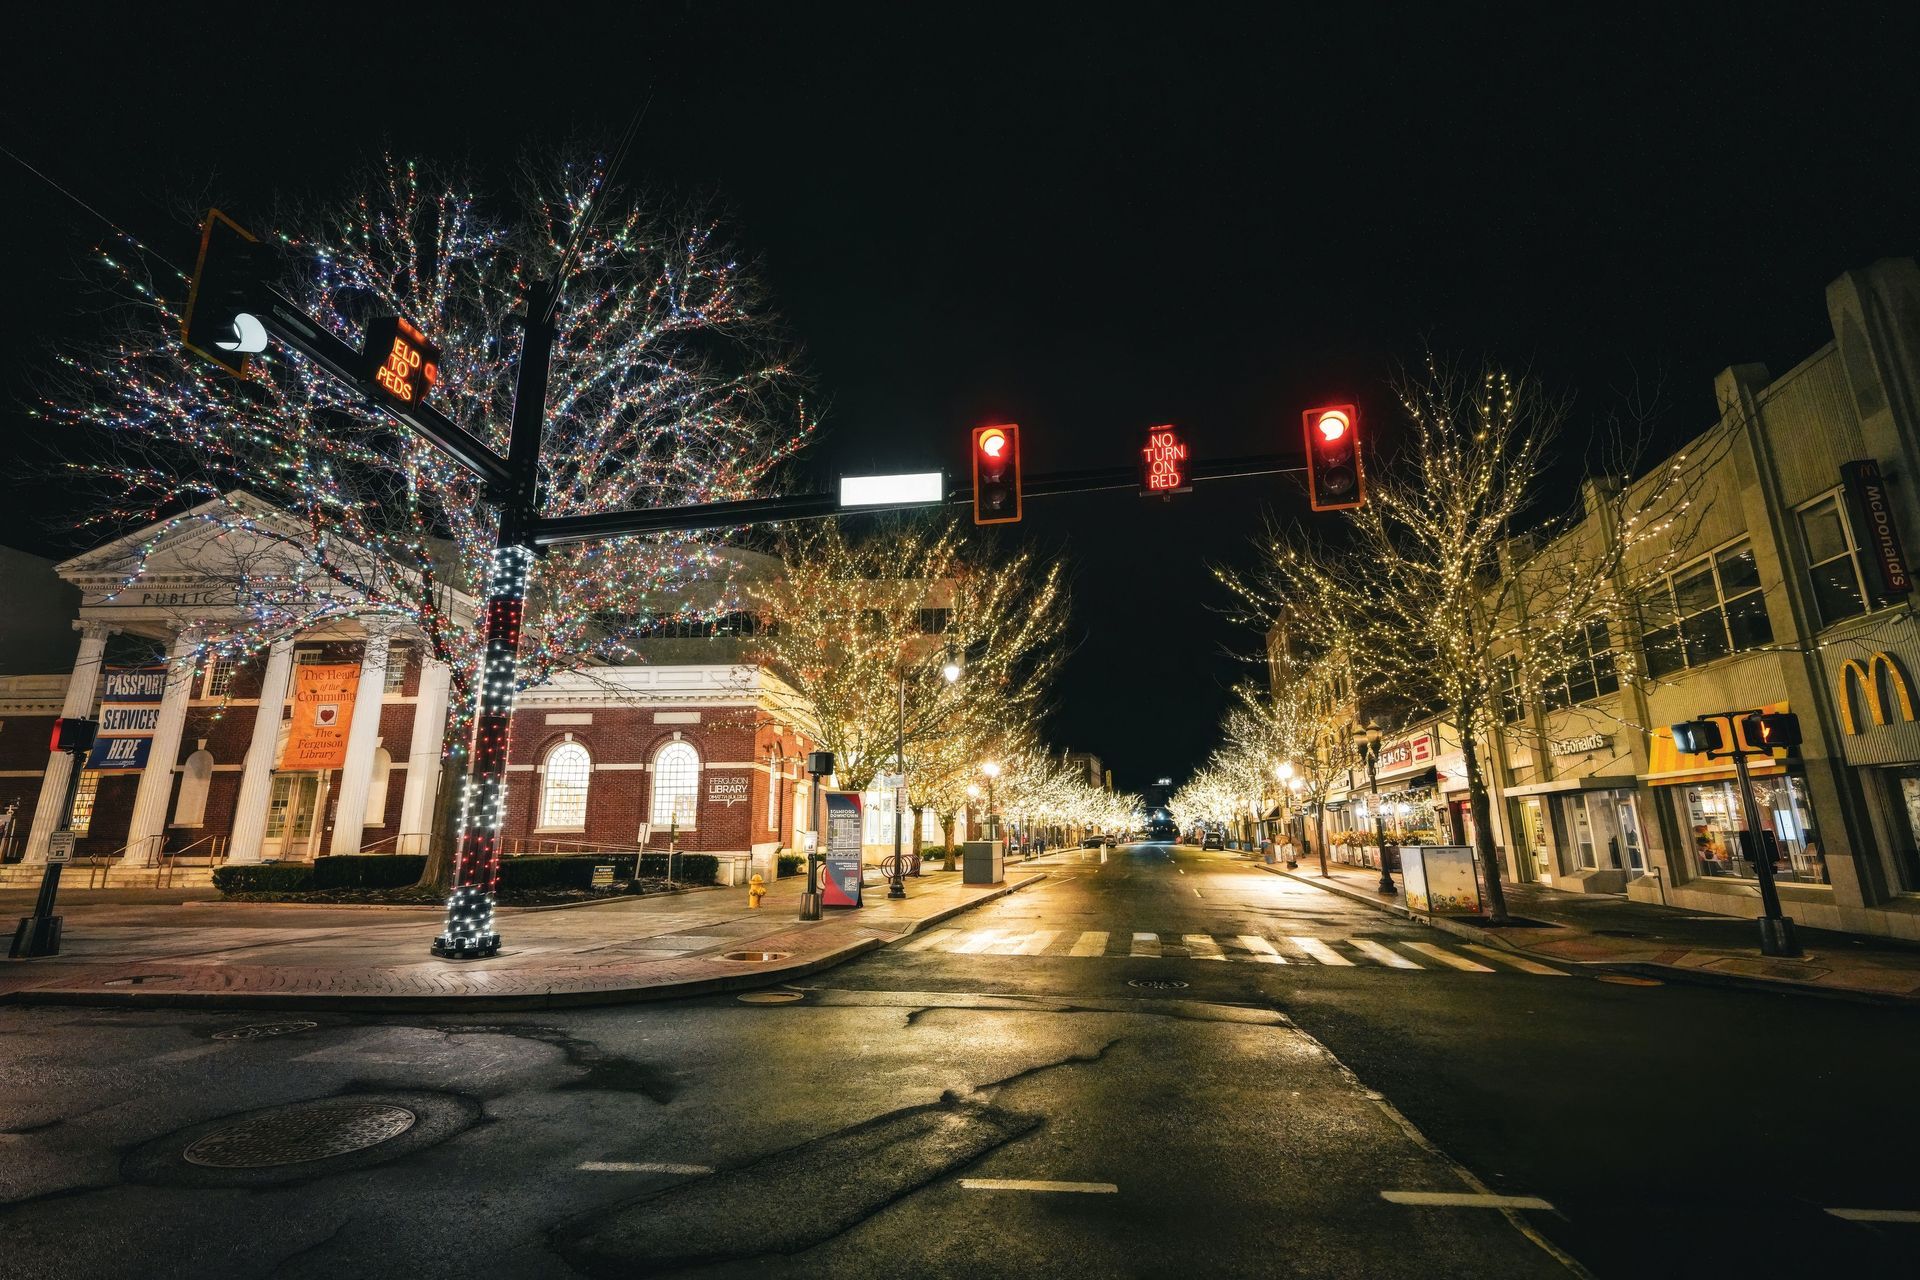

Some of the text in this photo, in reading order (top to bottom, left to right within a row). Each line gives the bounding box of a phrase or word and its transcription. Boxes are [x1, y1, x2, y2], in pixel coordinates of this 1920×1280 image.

[390, 353, 408, 377] TO
[377, 366, 412, 400] PEDS
[1151, 433, 1173, 448] NO
[1143, 444, 1184, 462] TURN
[1153, 460, 1175, 475] ON
[1150, 473, 1179, 488] RED
[1866, 485, 1905, 586] McDonald's
[142, 592, 215, 605] PUBLIC
[302, 669, 357, 681] The Heart
[105, 674, 166, 695] PASSPORT
[319, 683, 340, 692] of the
[297, 691, 357, 702] Community
[103, 709, 160, 730] SERVICES
[315, 728, 333, 738] The
[106, 739, 141, 760] HERE
[297, 739, 343, 749] Ferguson
[1551, 734, 1604, 756] McDonald's
[299, 749, 336, 760] Library
[709, 785, 748, 793] LIBRARY
